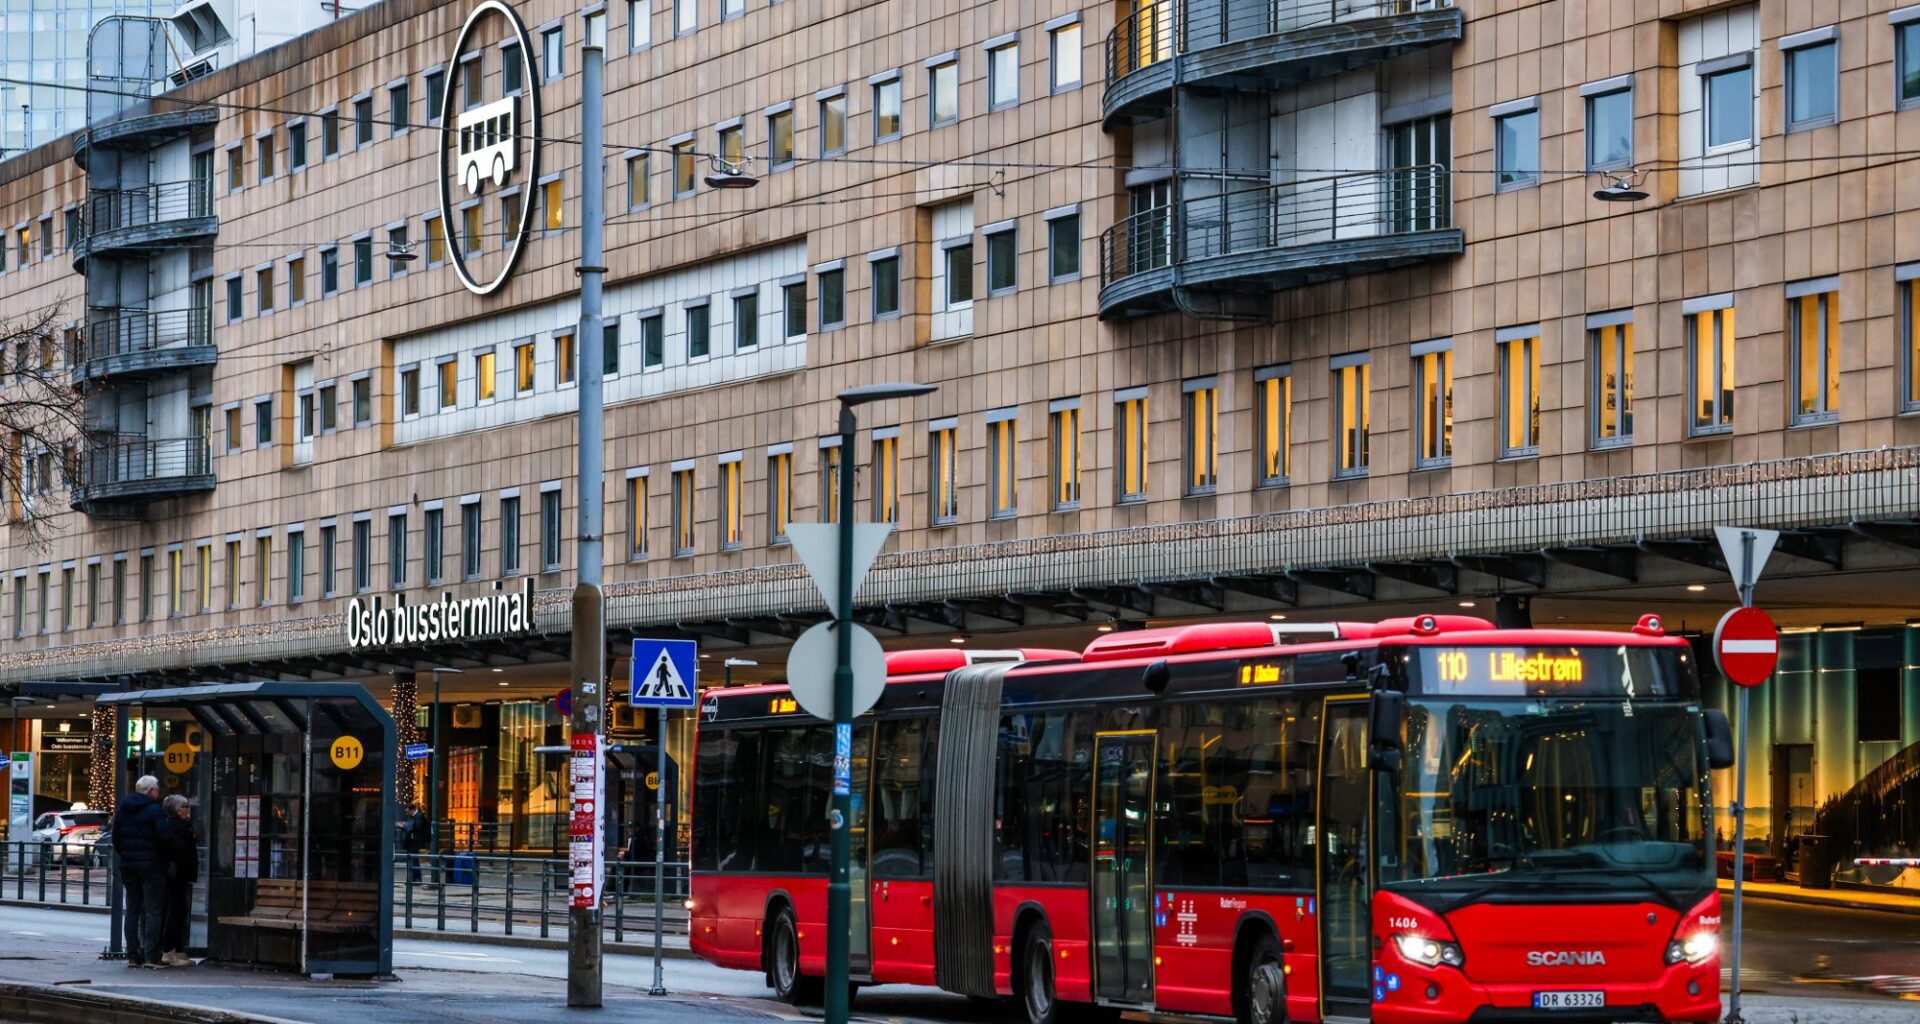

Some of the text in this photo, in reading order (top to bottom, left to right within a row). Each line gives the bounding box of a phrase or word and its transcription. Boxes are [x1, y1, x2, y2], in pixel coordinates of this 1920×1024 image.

[348, 577, 530, 647] Oslo bussterminal
[1438, 652, 1582, 681] 110 Lillestrøm
[168, 753, 190, 763] B11
[336, 747, 359, 758] B11
[1389, 917, 1417, 928] 1406
[1527, 951, 1606, 966] SCANIA
[1543, 993, 1602, 1006] DR 63326
